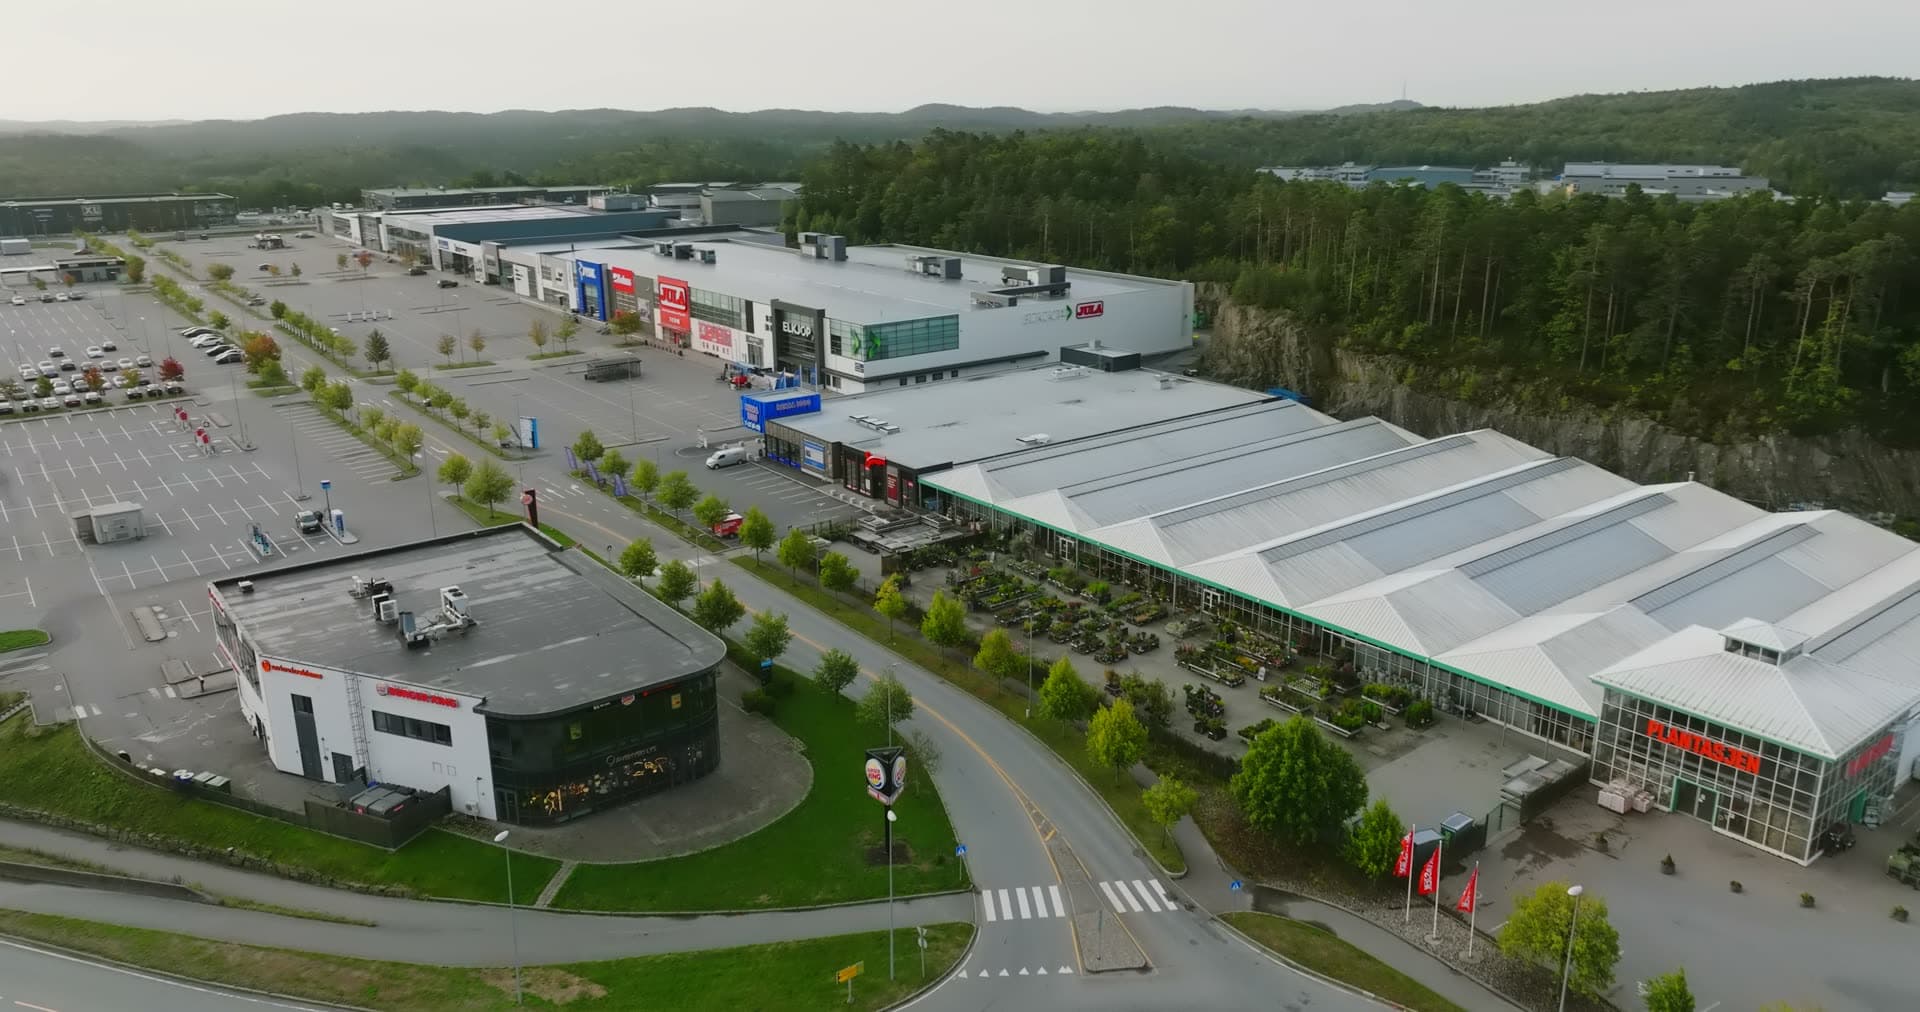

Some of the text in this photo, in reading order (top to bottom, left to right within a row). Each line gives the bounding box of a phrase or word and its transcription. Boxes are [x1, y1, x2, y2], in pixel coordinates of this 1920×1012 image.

[659, 286, 685, 307] JULA
[1077, 303, 1103, 317] JULA
[431, 695, 460, 709] KING
[1646, 719, 1760, 776] PLANTASJEN
